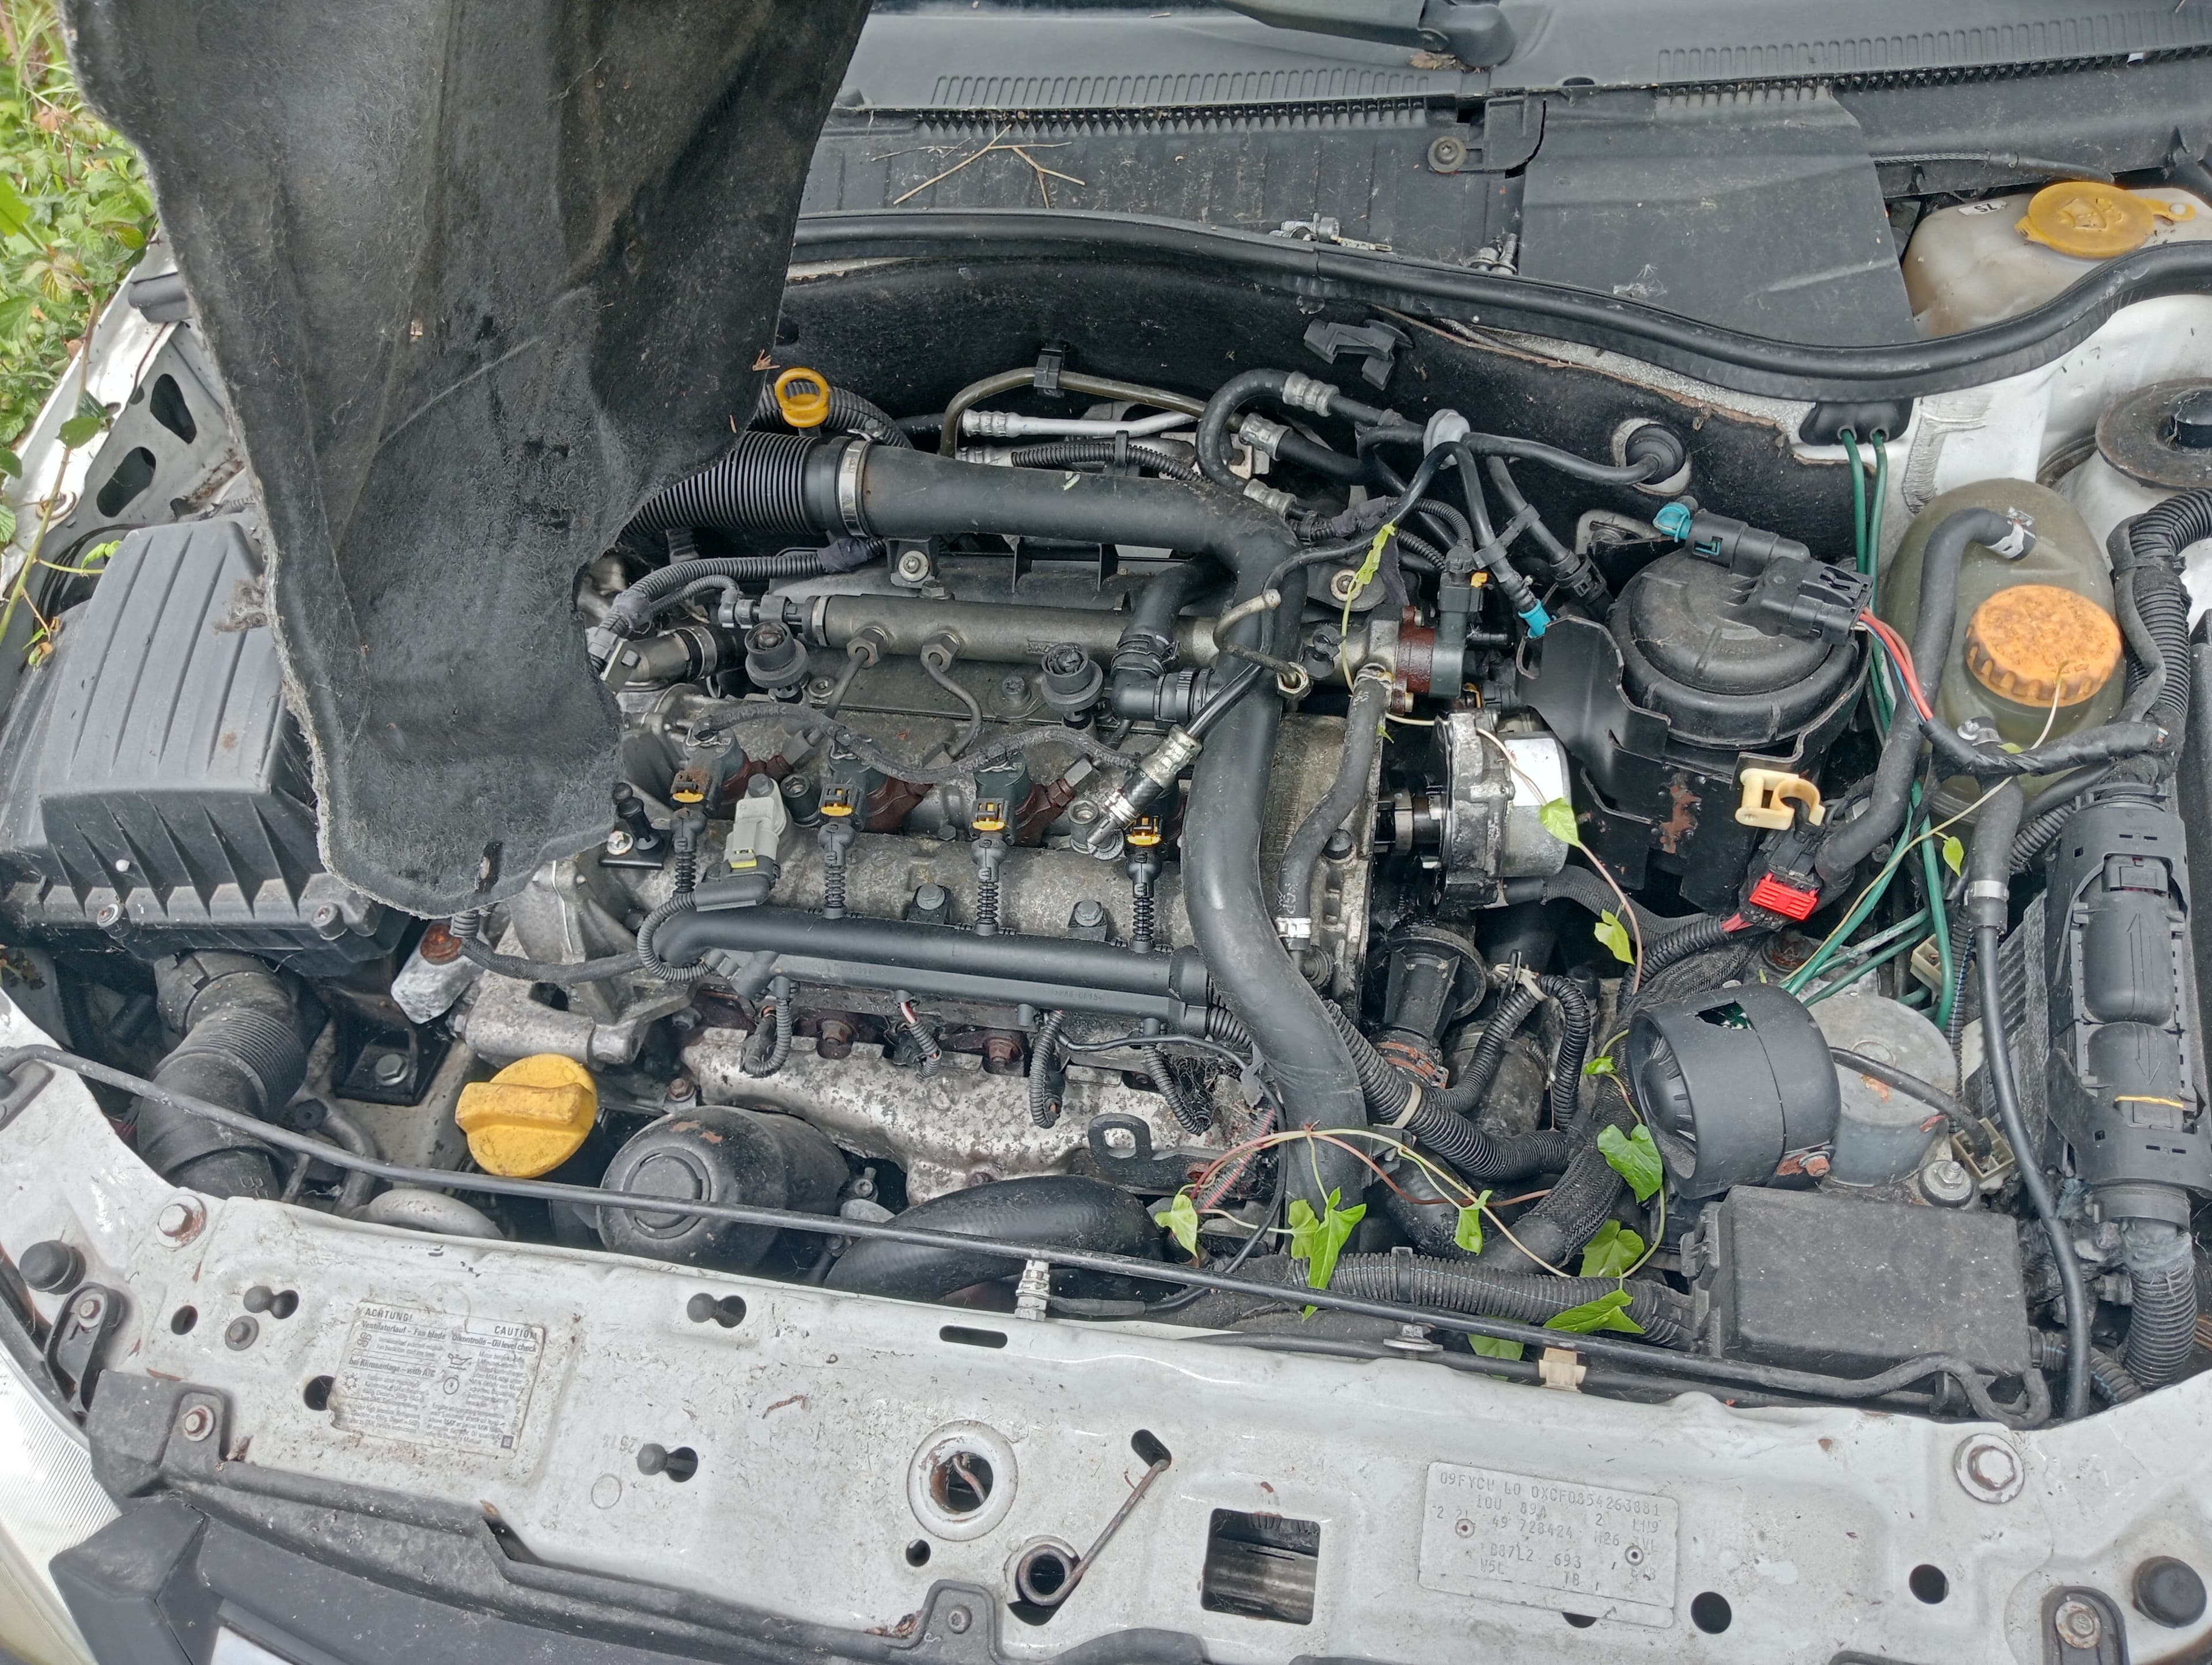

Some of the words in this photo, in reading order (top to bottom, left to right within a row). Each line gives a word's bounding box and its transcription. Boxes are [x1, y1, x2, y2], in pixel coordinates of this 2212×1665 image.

[365, 1307, 414, 1323] ACHTUNG!
[362, 1320, 407, 1335] Ventilatorlauf
[414, 1328, 426, 1337] Fan
[427, 1329, 446, 1340] blade
[494, 1325, 537, 1340] CAUTION
[492, 1339, 501, 1348] Oil
[502, 1340, 517, 1349] level
[518, 1344, 536, 1352] check
[1554, 1553, 1582, 1569] 693
